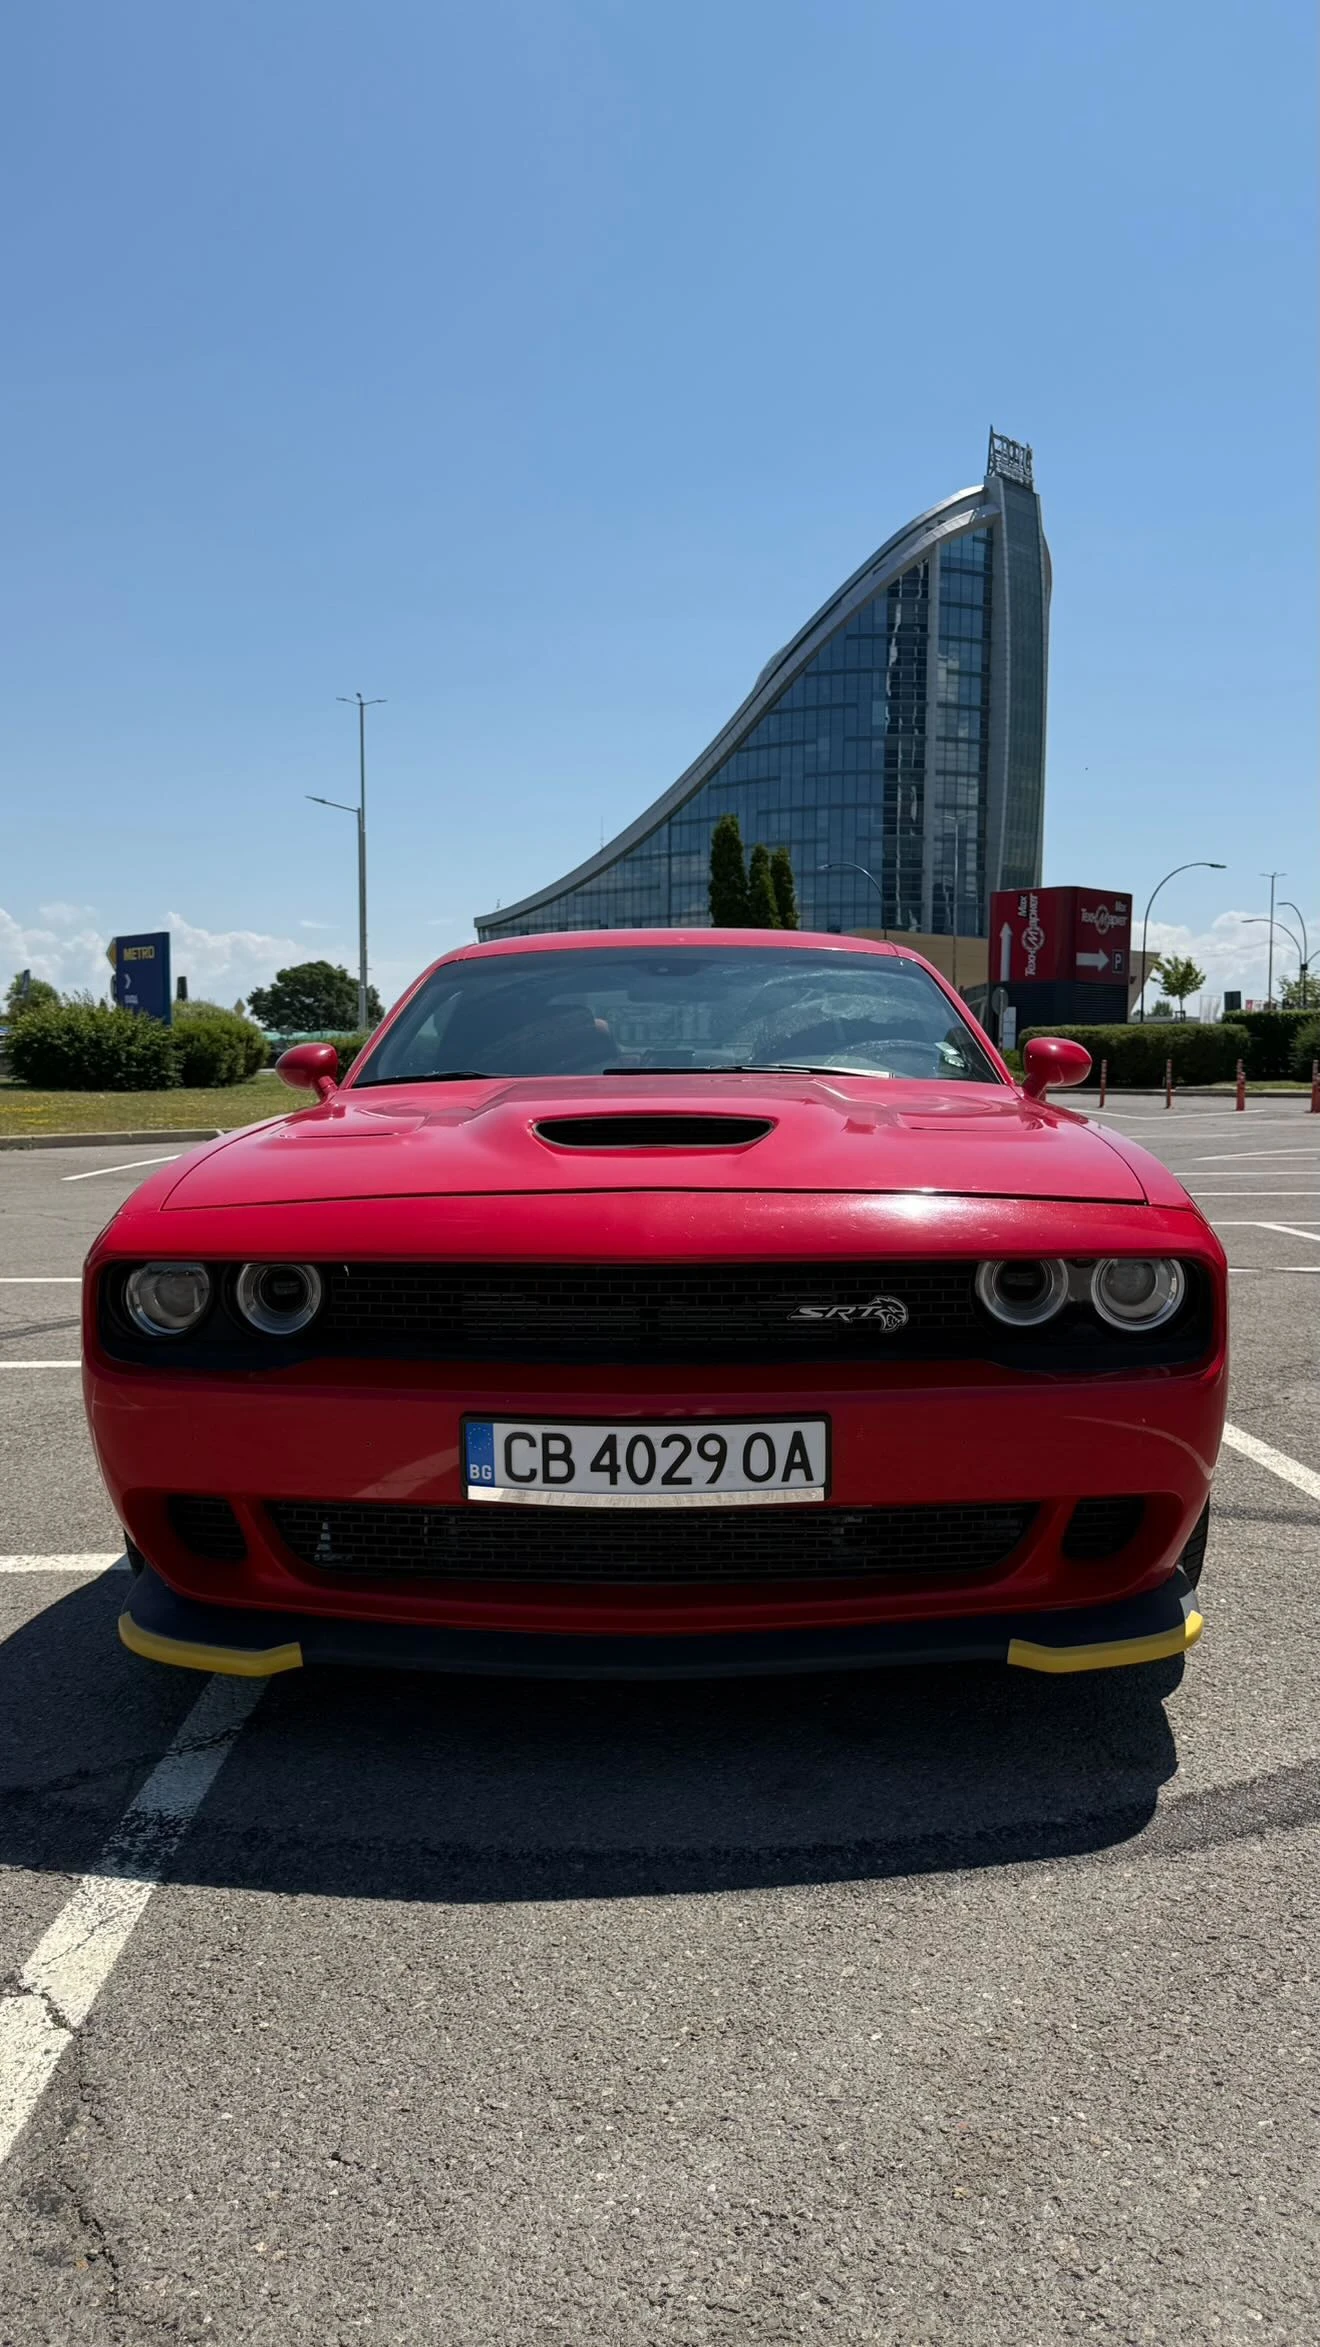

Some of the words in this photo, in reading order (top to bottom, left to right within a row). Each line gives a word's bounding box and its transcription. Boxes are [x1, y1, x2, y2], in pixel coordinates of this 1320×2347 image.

[123, 945, 155, 961] METRO
[1114, 953, 1122, 970] P
[790, 1306, 882, 1321] SRT
[504, 1431, 576, 1484] CB
[590, 1432, 728, 1486] 4029
[469, 1463, 493, 1481] BG
